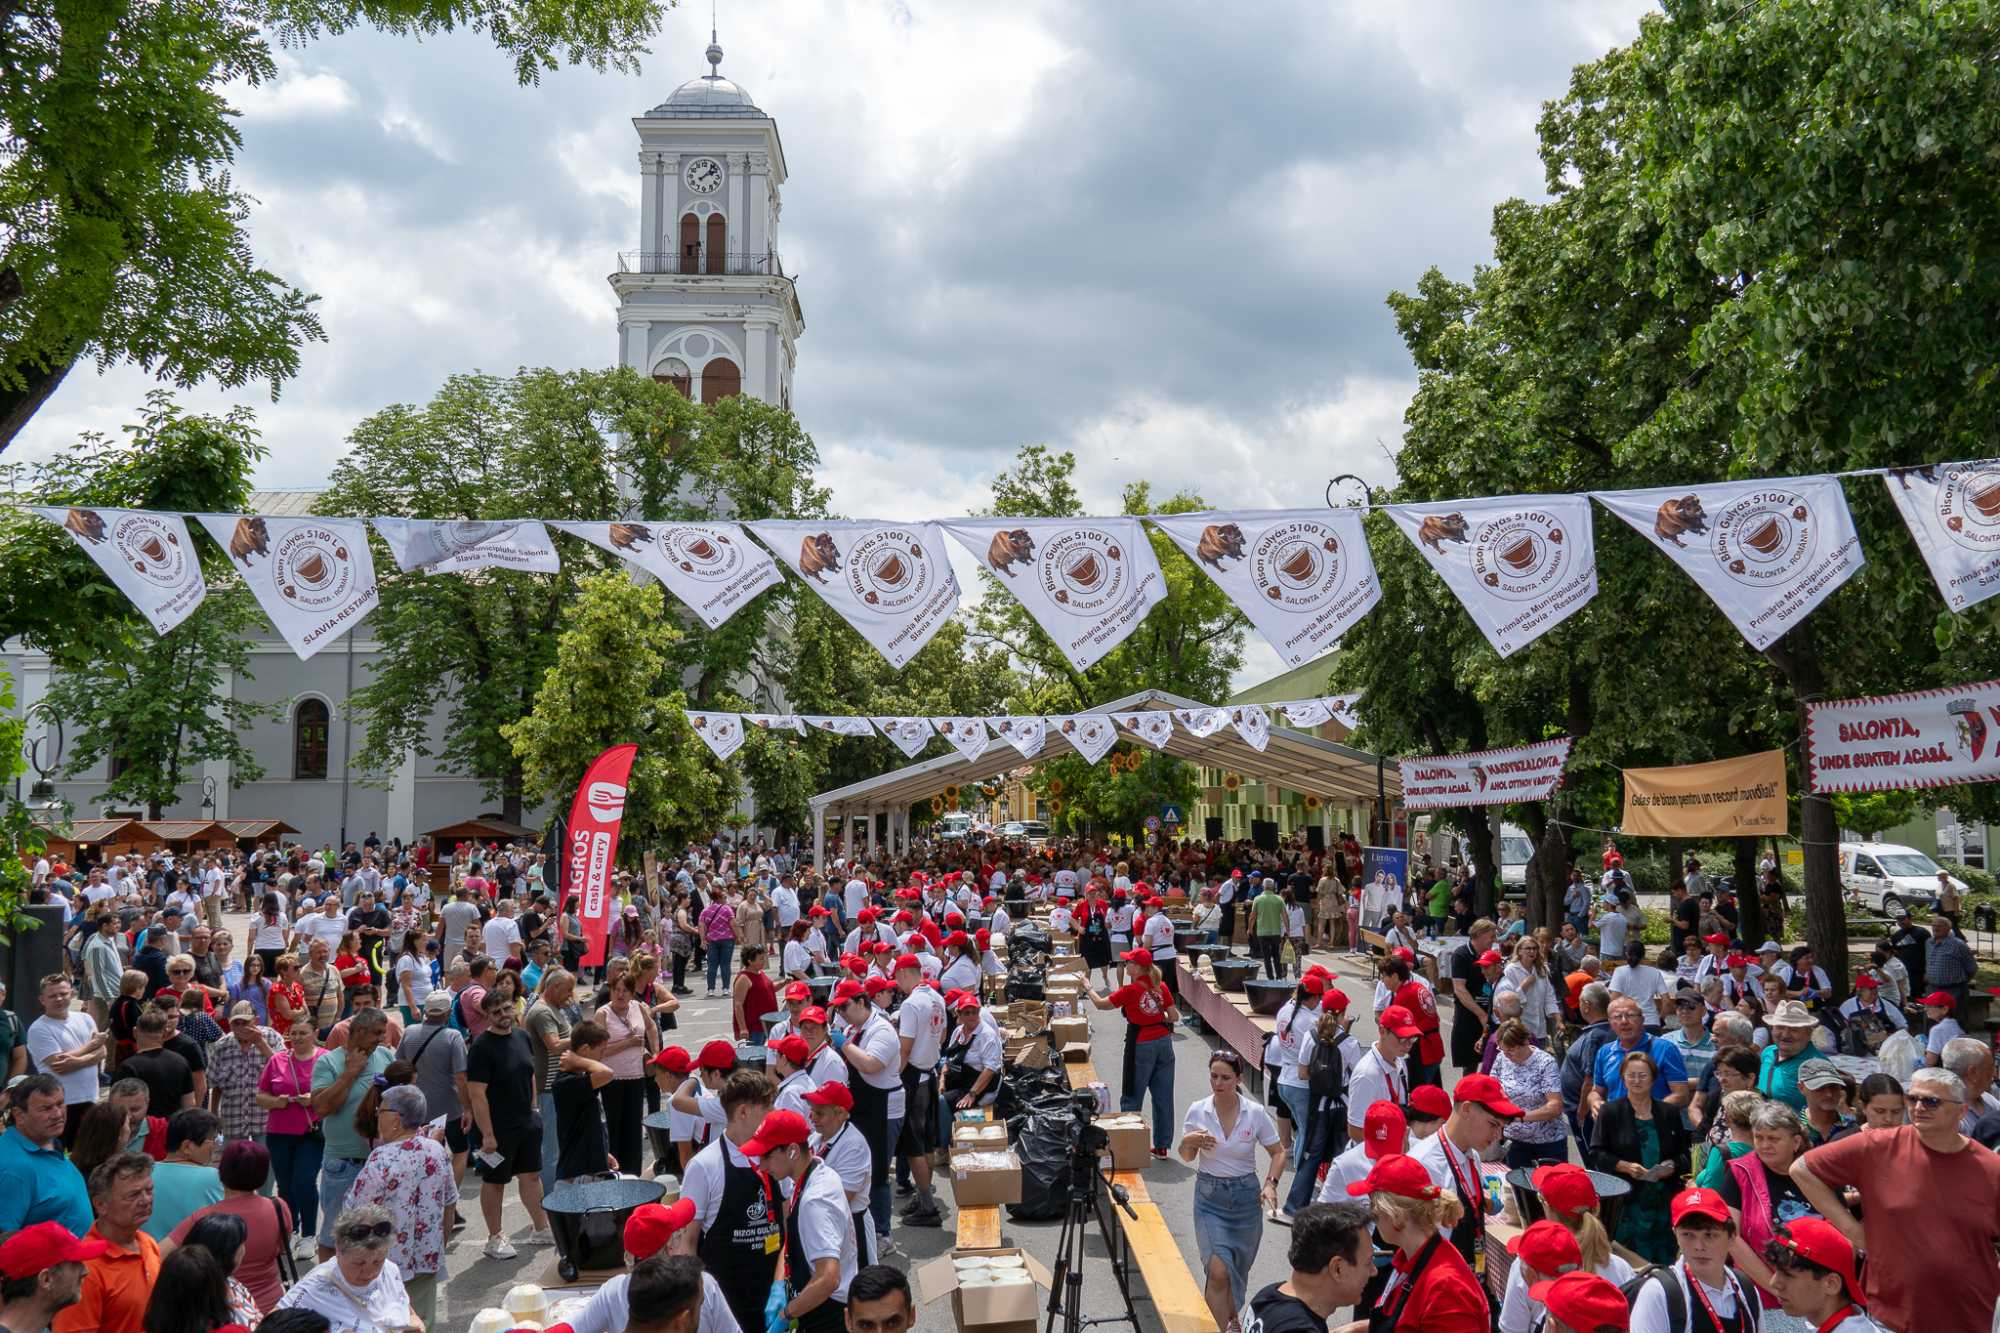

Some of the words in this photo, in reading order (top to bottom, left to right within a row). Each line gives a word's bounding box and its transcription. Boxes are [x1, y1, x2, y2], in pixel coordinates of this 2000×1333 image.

[1941, 484, 1953, 515] Bison
[1074, 531, 1103, 541] 5100
[1289, 523, 1319, 534] 5100
[1319, 529, 1327, 538] L
[1718, 532, 1731, 562] Bison
[1753, 493, 1785, 503] 5100
[1787, 497, 1795, 506] L
[1045, 535, 1073, 560] Gulyás
[1103, 537, 1110, 546] L
[1258, 527, 1287, 556] Gulyás
[1475, 545, 1487, 574] Bison
[1514, 512, 1545, 524] 5100
[1546, 519, 1554, 528] L
[277, 559, 286, 586] Bison
[306, 529, 331, 542] 5100
[332, 539, 339, 547] L
[851, 568, 865, 594] Bison
[876, 531, 904, 542] 5100
[904, 536, 911, 545] L
[1045, 563, 1057, 592] Bison
[1256, 558, 1269, 588] Bison
[1748, 567, 1787, 579] SALONTA
[1501, 583, 1538, 593] SALONTA
[1529, 576, 1580, 614] Municipiului
[1777, 598, 1805, 621] Slavia
[1807, 558, 1851, 597] Restaurant
[1071, 599, 1105, 609] SALONTA
[1285, 594, 1320, 605] SALONTA
[1315, 586, 1362, 624] Municipiului
[1952, 594, 1965, 606] 22
[710, 616, 720, 626] 18
[1309, 623, 1334, 643] Slavia
[1336, 587, 1376, 622] Restaurant
[1521, 612, 1549, 632] Slavia
[159, 622, 169, 631] 25
[910, 619, 931, 642] Slavia
[1093, 624, 1118, 646] Slavia
[1756, 634, 1769, 646] 21
[894, 654, 905, 665] 17
[1076, 656, 1088, 668] 15
[1290, 654, 1301, 665] 16
[1839, 717, 1921, 743] SALONTA,
[1819, 755, 1852, 771] UNDE
[1853, 751, 1900, 768] SUNTEM
[1652, 793, 1661, 806] de
[1679, 793, 1702, 808] pentru
[1702, 793, 1713, 804] un
[1712, 786, 1738, 803] record
[595, 838, 608, 870] carry
[591, 873, 601, 882] &
[590, 885, 600, 911] cash
[733, 1229, 756, 1237] BIZON
